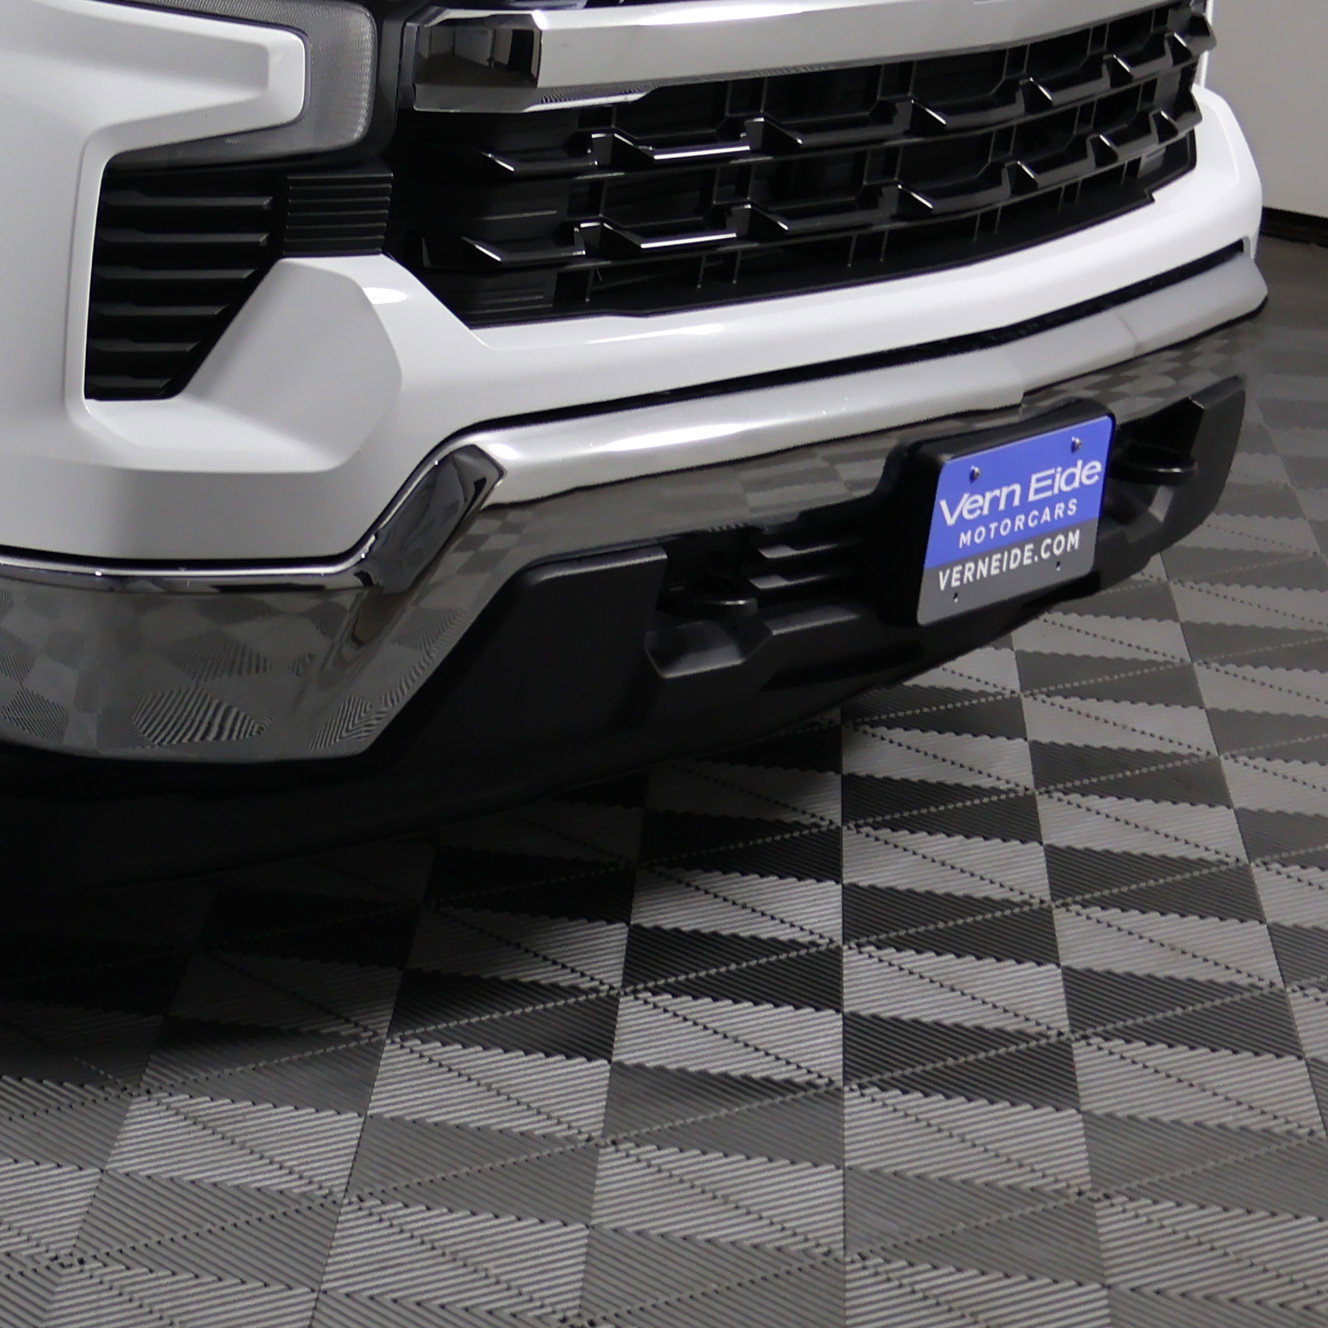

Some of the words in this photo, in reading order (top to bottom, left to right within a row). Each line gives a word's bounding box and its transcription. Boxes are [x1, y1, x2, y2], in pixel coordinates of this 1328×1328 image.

[939, 482, 1022, 527] Vern
[1027, 459, 1103, 502] Eide
[958, 498, 1078, 549] MOTORCARS
[938, 528, 1081, 591] VERNEIDE.COM
